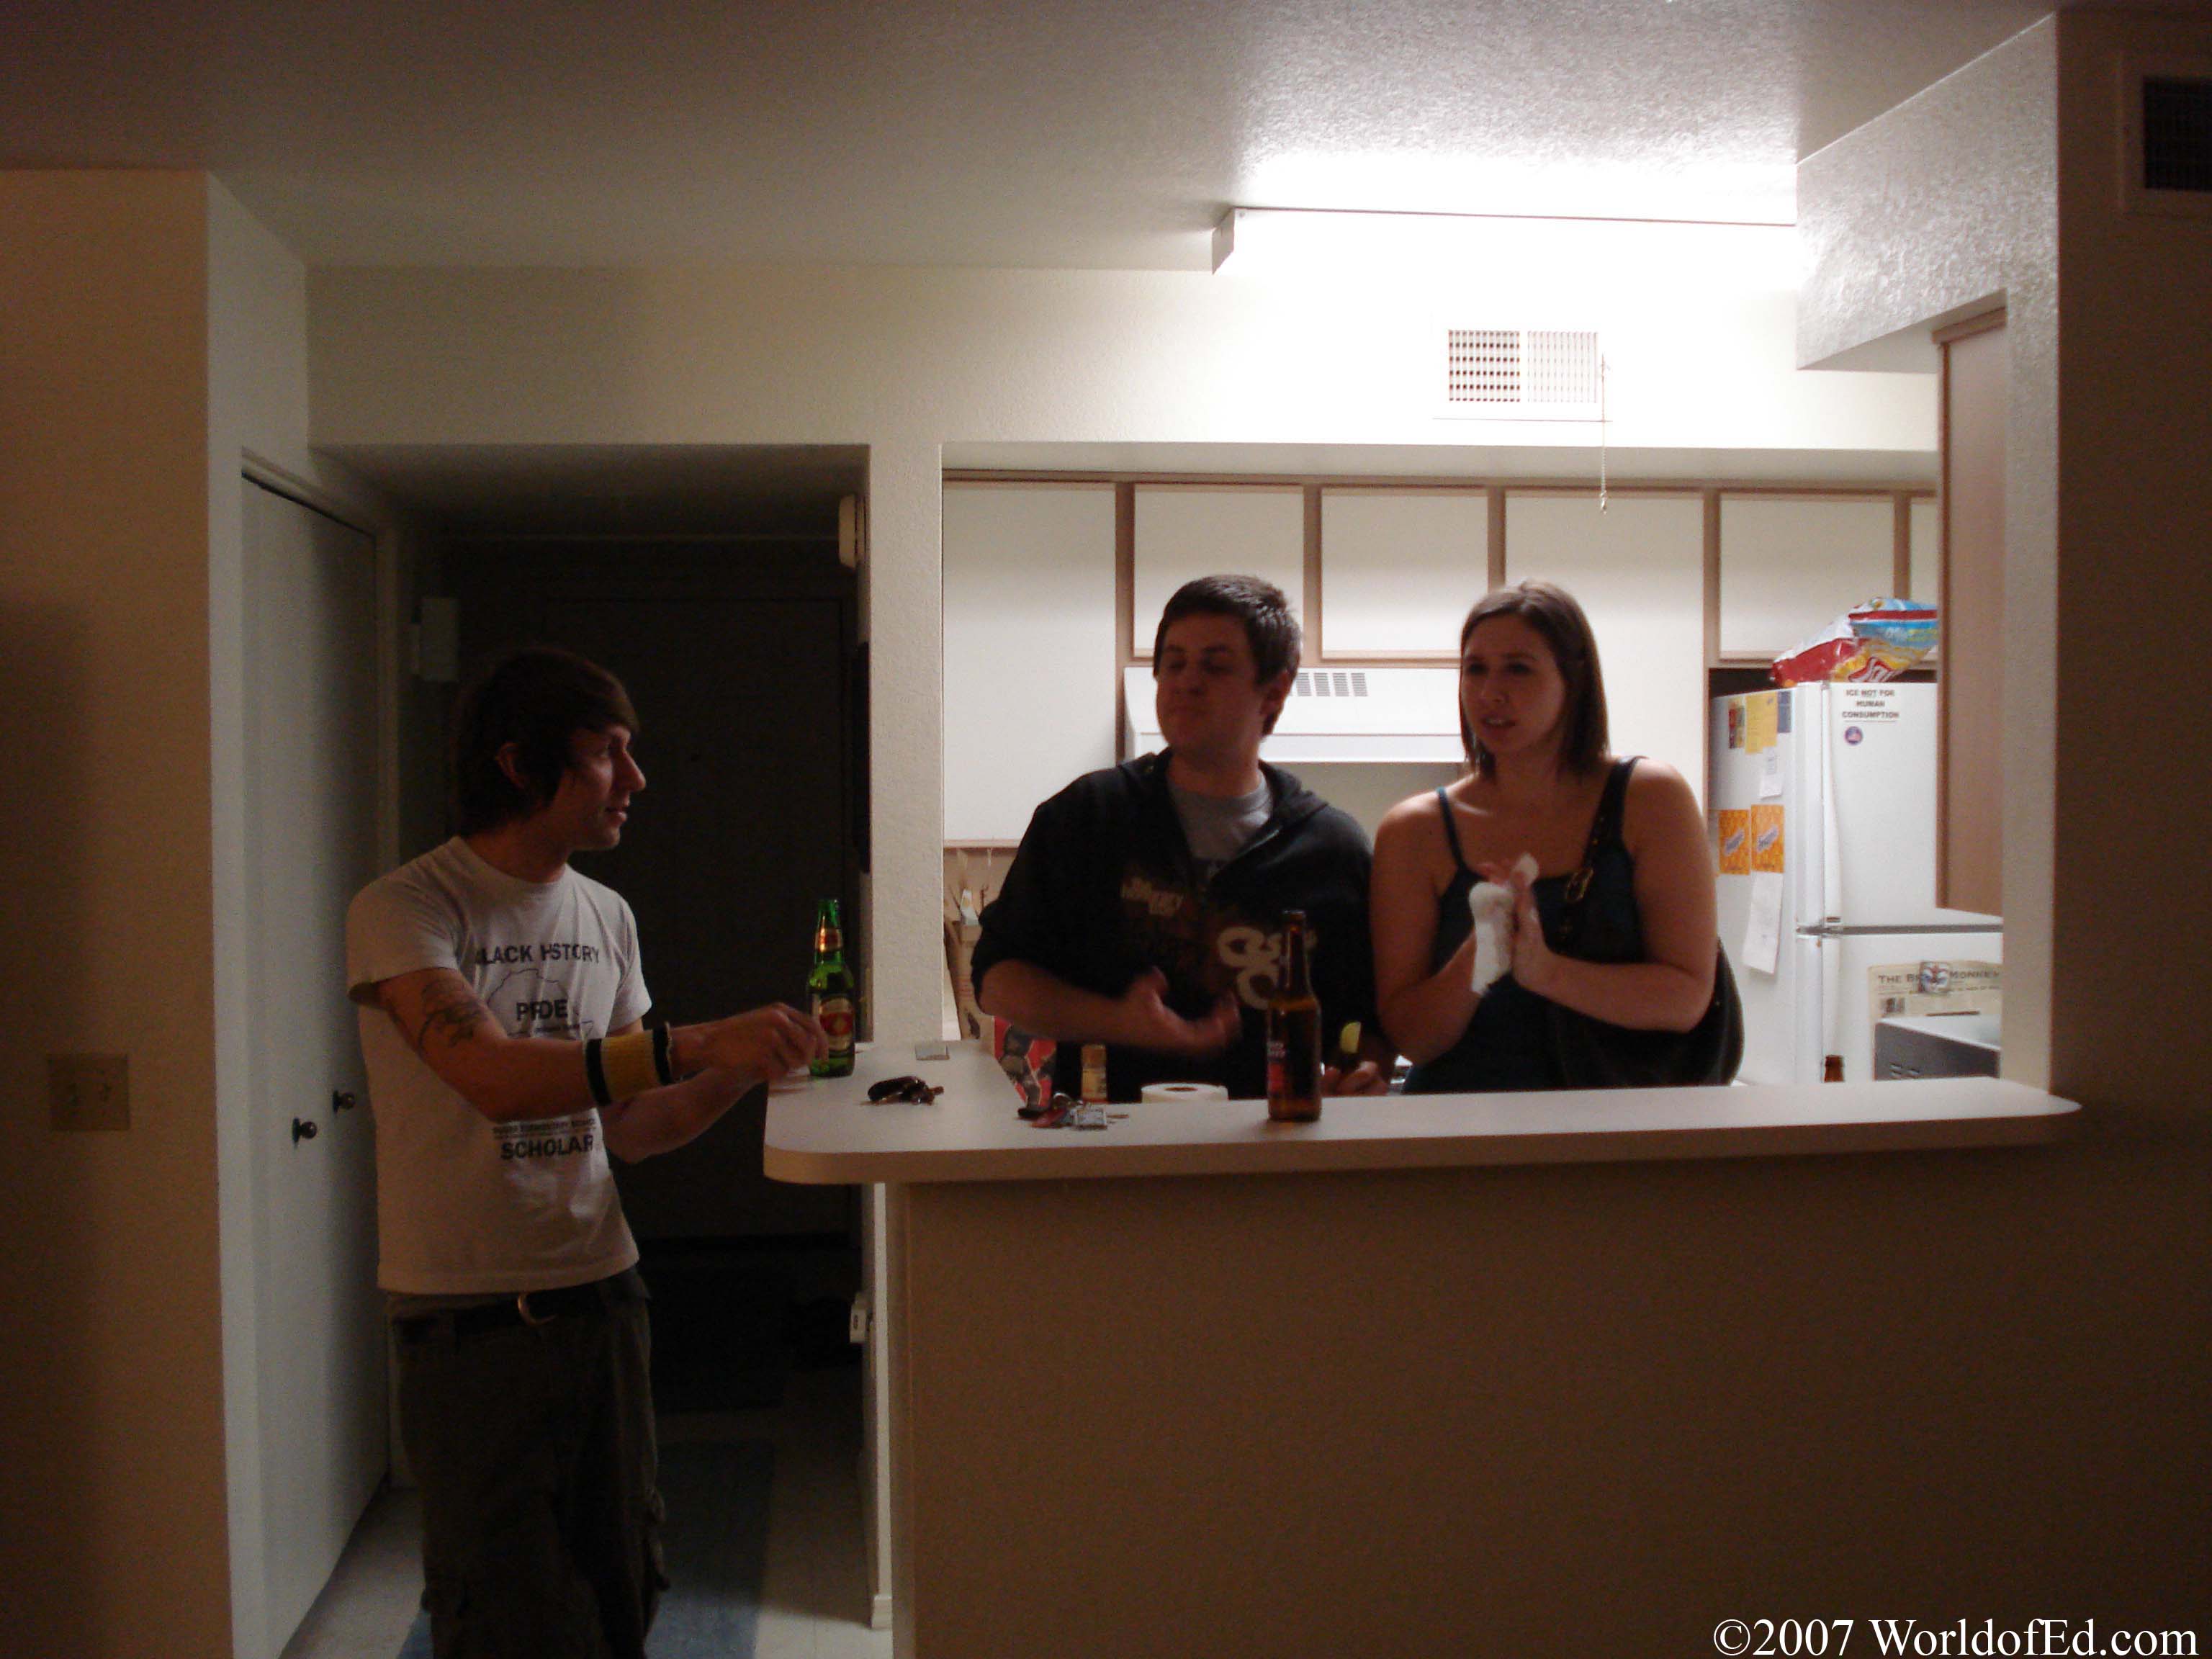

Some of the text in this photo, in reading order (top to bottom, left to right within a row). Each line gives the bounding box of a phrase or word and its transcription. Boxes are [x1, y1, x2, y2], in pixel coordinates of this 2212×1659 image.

[1877, 974, 1902, 984] THE
[1950, 970, 2000, 980] MONKEY
[500, 1133, 593, 1160] SCHOLAR
